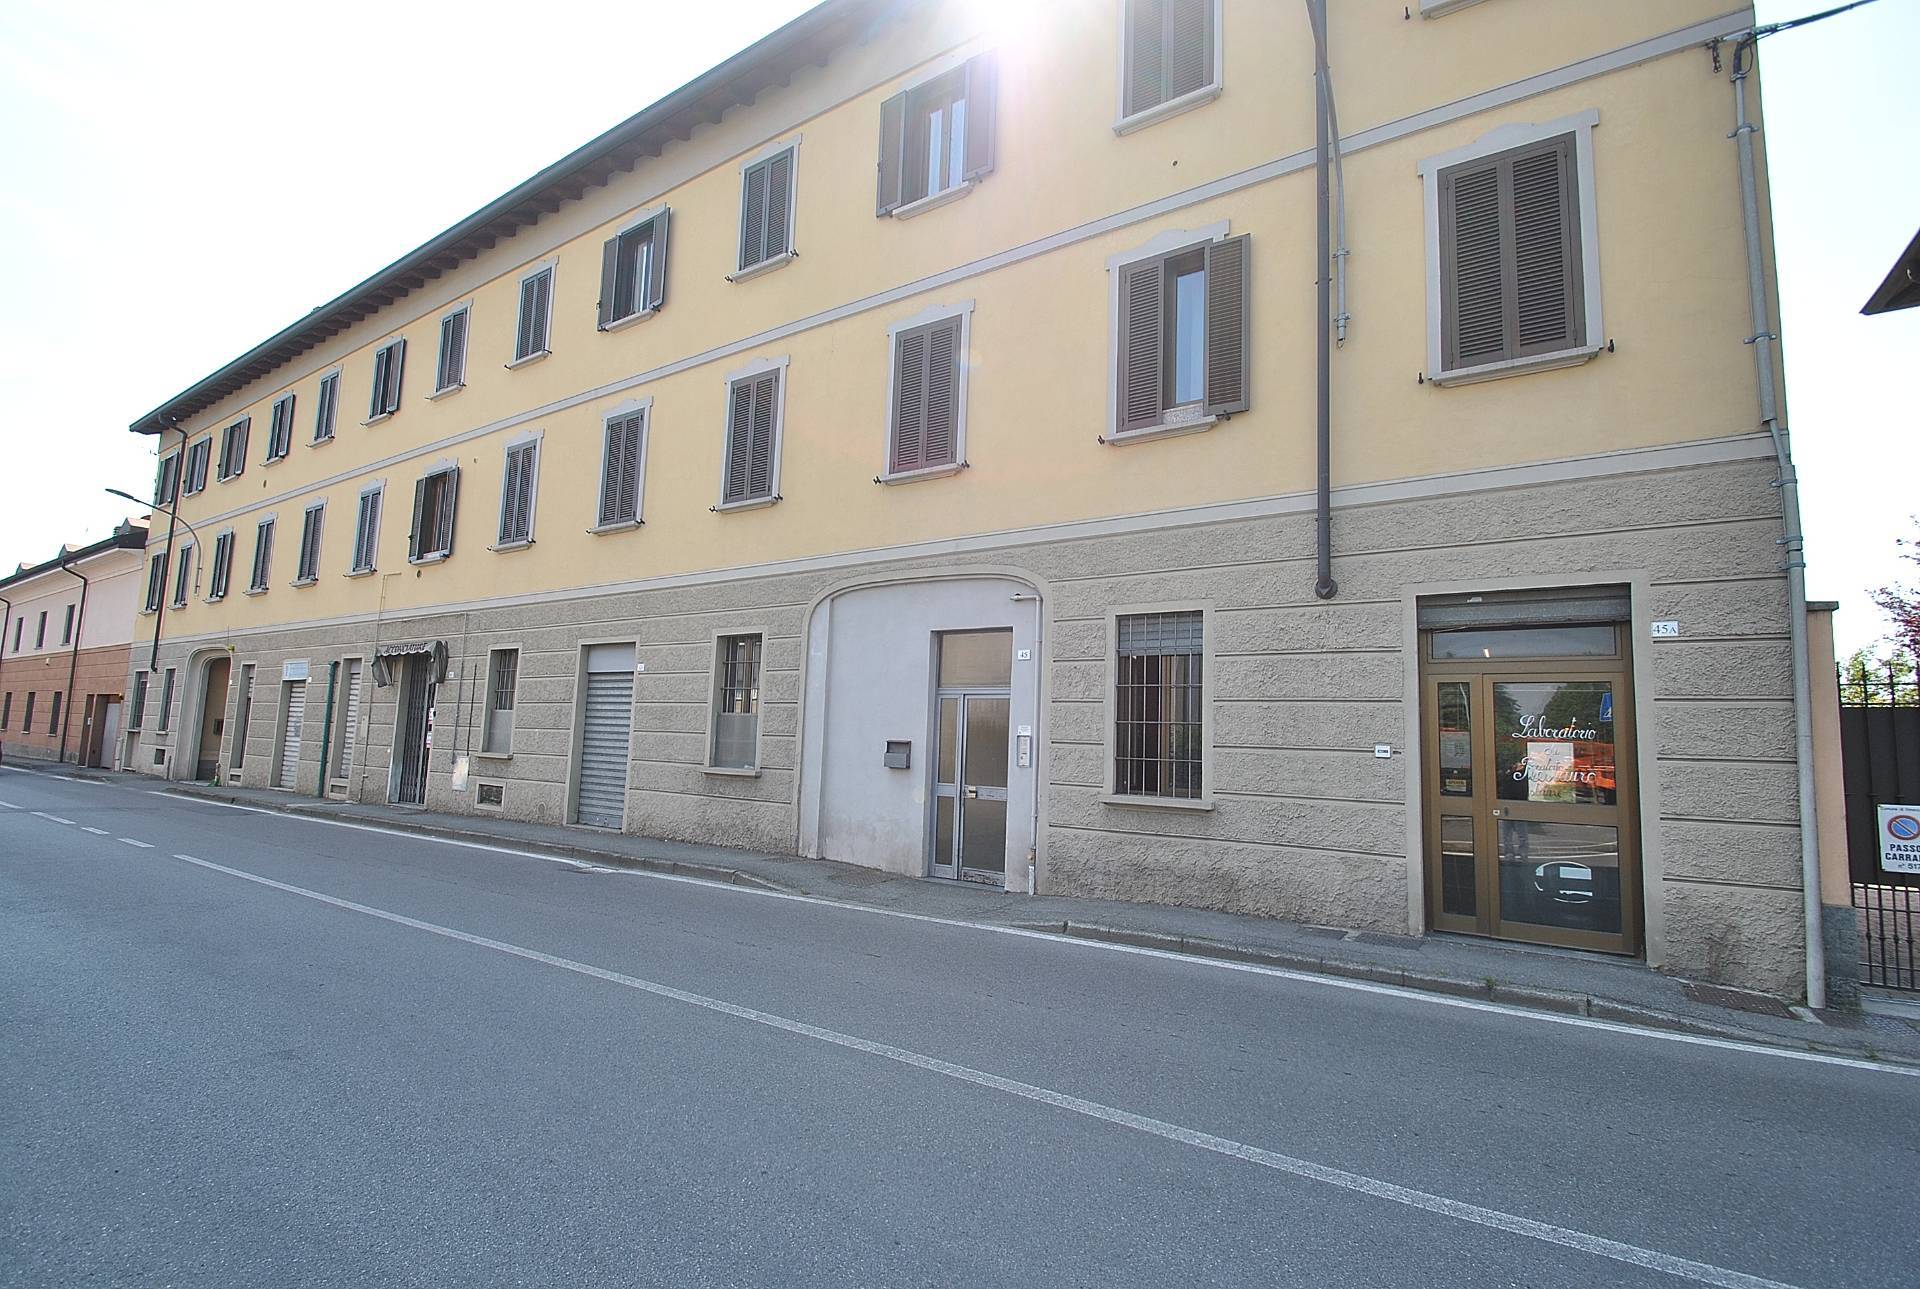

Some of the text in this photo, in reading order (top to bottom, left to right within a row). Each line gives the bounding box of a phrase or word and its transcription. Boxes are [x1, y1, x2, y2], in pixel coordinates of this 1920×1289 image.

[1652, 624, 1677, 635] 45A
[1512, 715, 1597, 739] Laboratorio
[1885, 853, 1920, 862] CARRA
